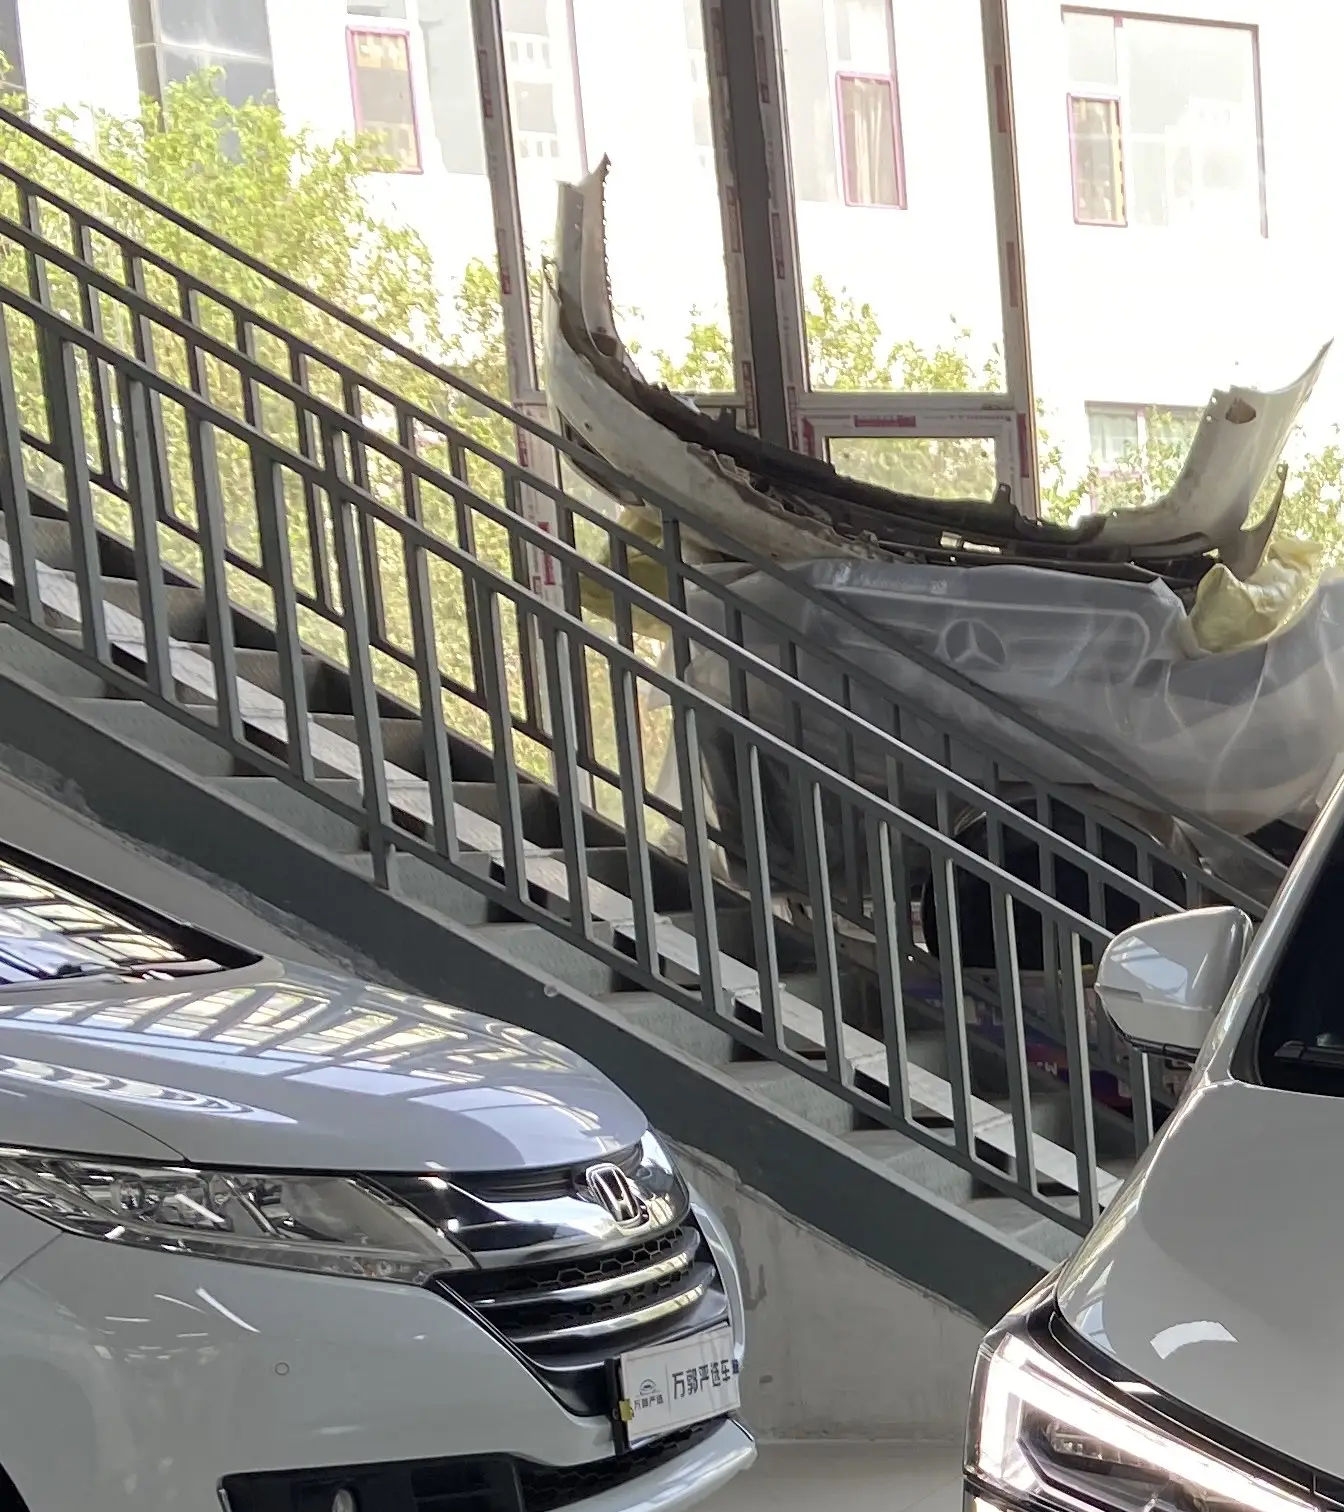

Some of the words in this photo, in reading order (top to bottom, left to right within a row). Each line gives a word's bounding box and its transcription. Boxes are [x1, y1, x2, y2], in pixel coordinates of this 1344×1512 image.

[671, 1358, 732, 1400] 万郭严选车
